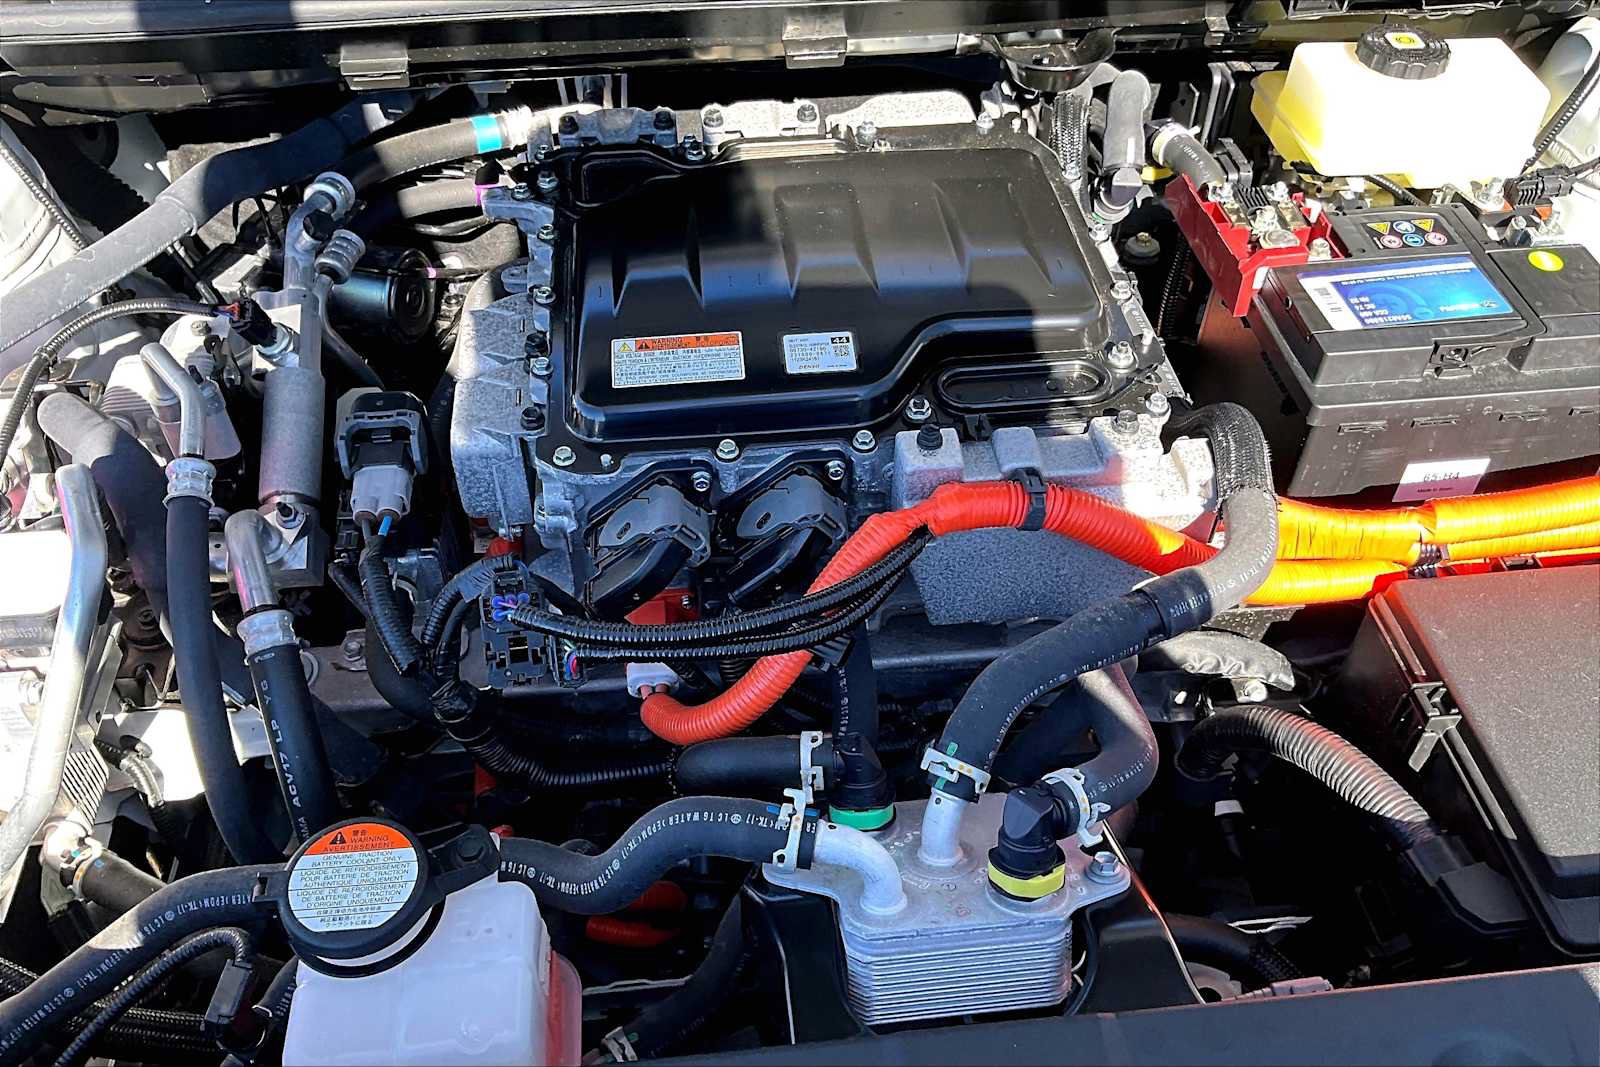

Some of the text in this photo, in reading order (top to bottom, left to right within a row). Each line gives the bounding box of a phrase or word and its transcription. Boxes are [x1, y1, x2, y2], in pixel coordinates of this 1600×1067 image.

[271, 719, 283, 743] LP
[668, 811, 700, 825] WATER
[745, 812, 769, 828] TK-17
[350, 835, 389, 844] WARNING
[323, 842, 394, 852] AVERTISSEMENT
[323, 853, 353, 861] GENUINE
[300, 869, 329, 877] LIQUIDE
[344, 863, 411, 873] REFROIDISSEMENT
[323, 873, 357, 881] BATTERIE
[374, 869, 409, 877] TRACTION
[303, 875, 404, 888] AUTHENTIQUE UNIQUEMENT
[296, 889, 325, 897] LIQUIDE
[342, 883, 408, 894] REFROIDISSEMENT
[315, 893, 348, 902] BATTERIE
[366, 890, 402, 898] TRACTION
[177, 901, 199, 915] TK-17
[306, 897, 394, 909] D'ORIGINE UNIQUEMENT
